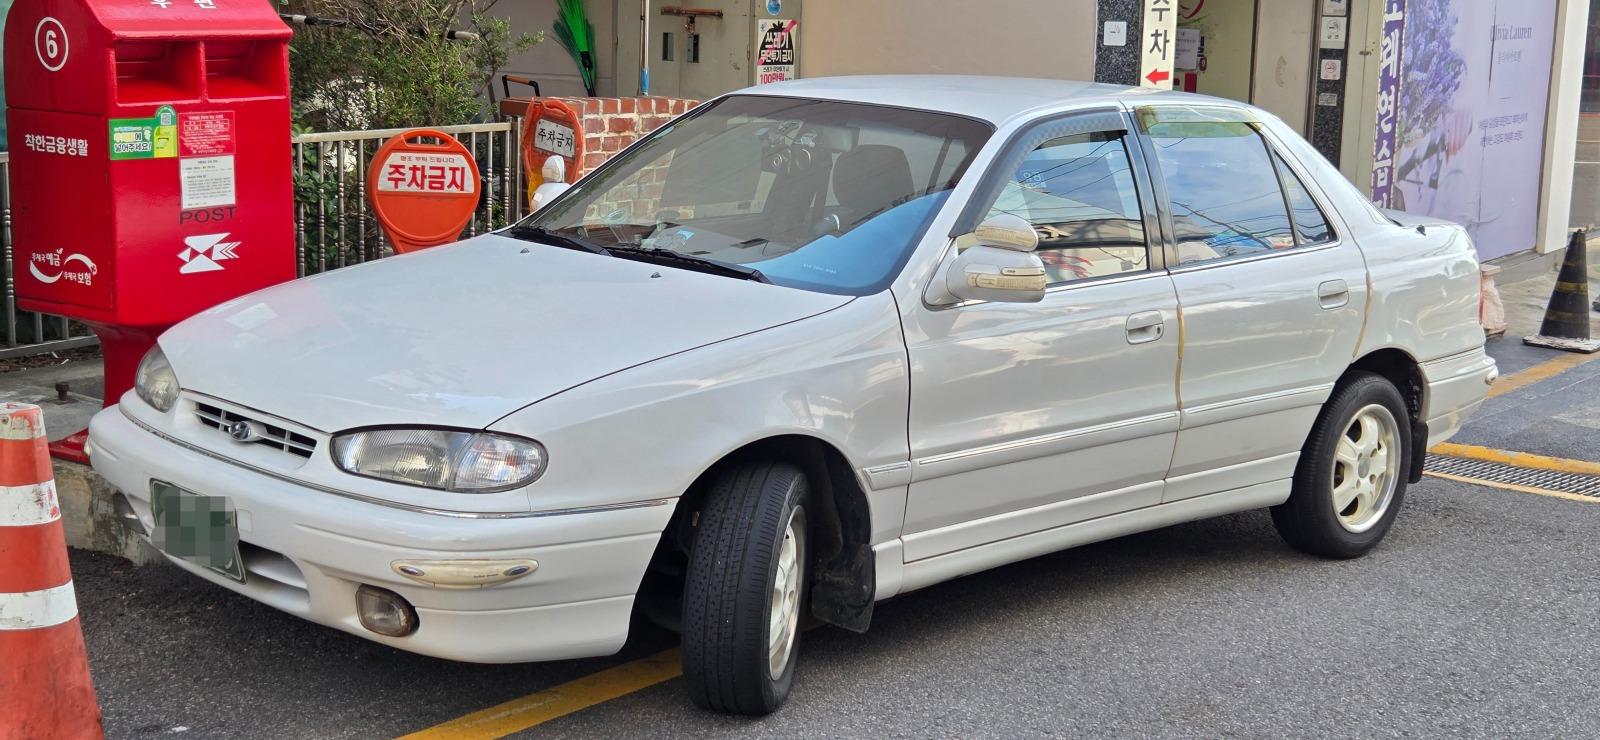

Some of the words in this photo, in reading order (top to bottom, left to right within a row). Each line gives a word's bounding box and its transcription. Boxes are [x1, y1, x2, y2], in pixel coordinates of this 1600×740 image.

[45, 30, 58, 59] 6
[765, 32, 789, 49] 쓰레기
[782, 50, 793, 62] 금지
[24, 133, 89, 157] 착한금융생활
[538, 127, 573, 152] 주차금지
[387, 164, 466, 192] 주차금지
[179, 206, 237, 224] POST
[77, 271, 92, 286] 보험
